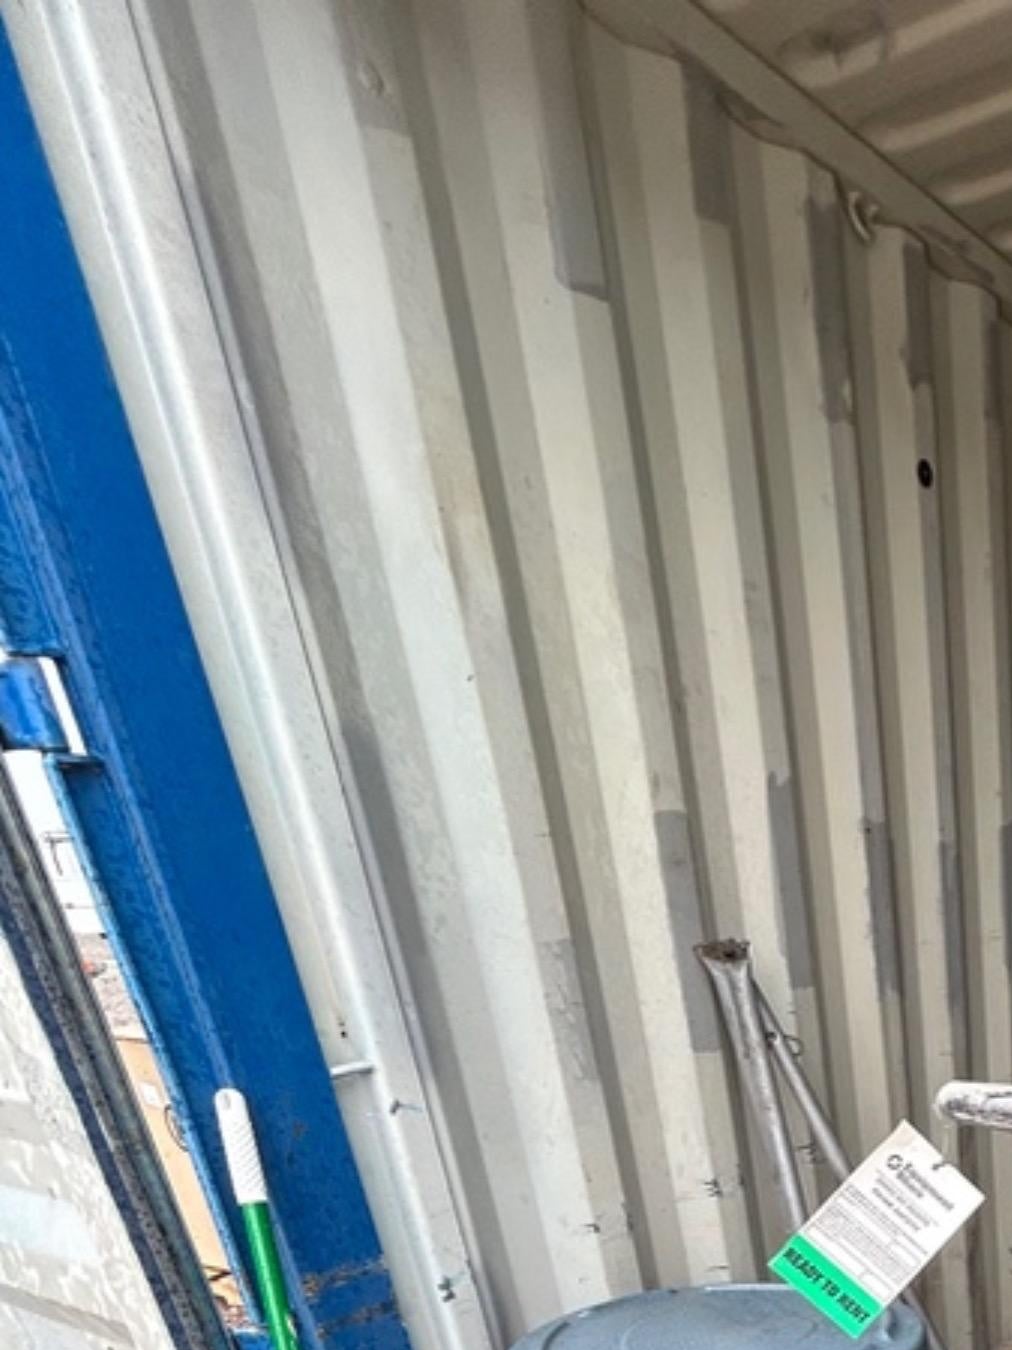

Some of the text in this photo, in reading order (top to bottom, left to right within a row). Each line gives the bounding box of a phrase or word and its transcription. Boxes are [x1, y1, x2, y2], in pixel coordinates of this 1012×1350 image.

[781, 1248, 870, 1323] READY TO RENT
